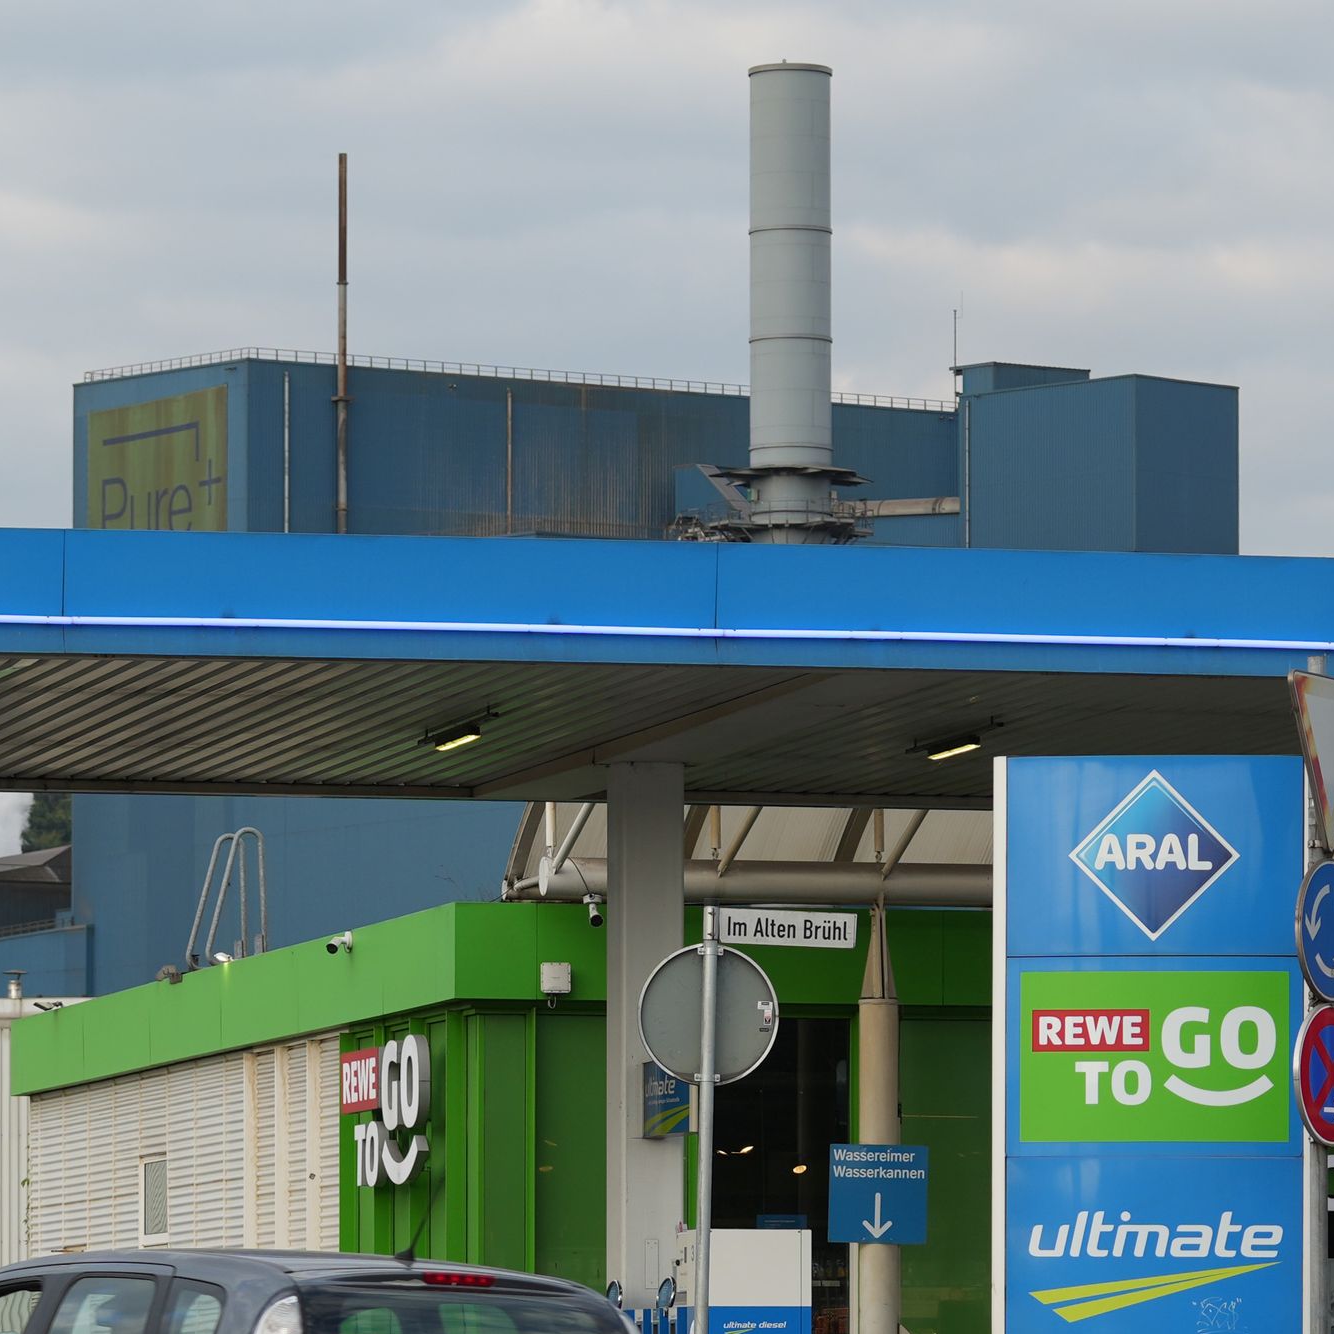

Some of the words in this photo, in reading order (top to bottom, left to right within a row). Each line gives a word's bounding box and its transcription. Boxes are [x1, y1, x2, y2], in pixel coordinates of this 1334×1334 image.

[1094, 833, 1213, 871] ARAL
[727, 916, 747, 937] Im
[753, 917, 796, 939] Alten
[803, 919, 848, 941] Brühl
[1038, 1015, 1144, 1046] REWE
[1075, 1060, 1152, 1106] TO
[1161, 1006, 1277, 1070] GO
[342, 1057, 377, 1105] REWE
[354, 1120, 379, 1188] TO
[381, 1034, 420, 1131] GO
[833, 1148, 915, 1163] Wassereimer
[833, 1165, 925, 1179] Wasserkannen
[1028, 1210, 1284, 1258] ultimate
[723, 1321, 757, 1329] ultimate
[758, 1321, 787, 1329] diesel
